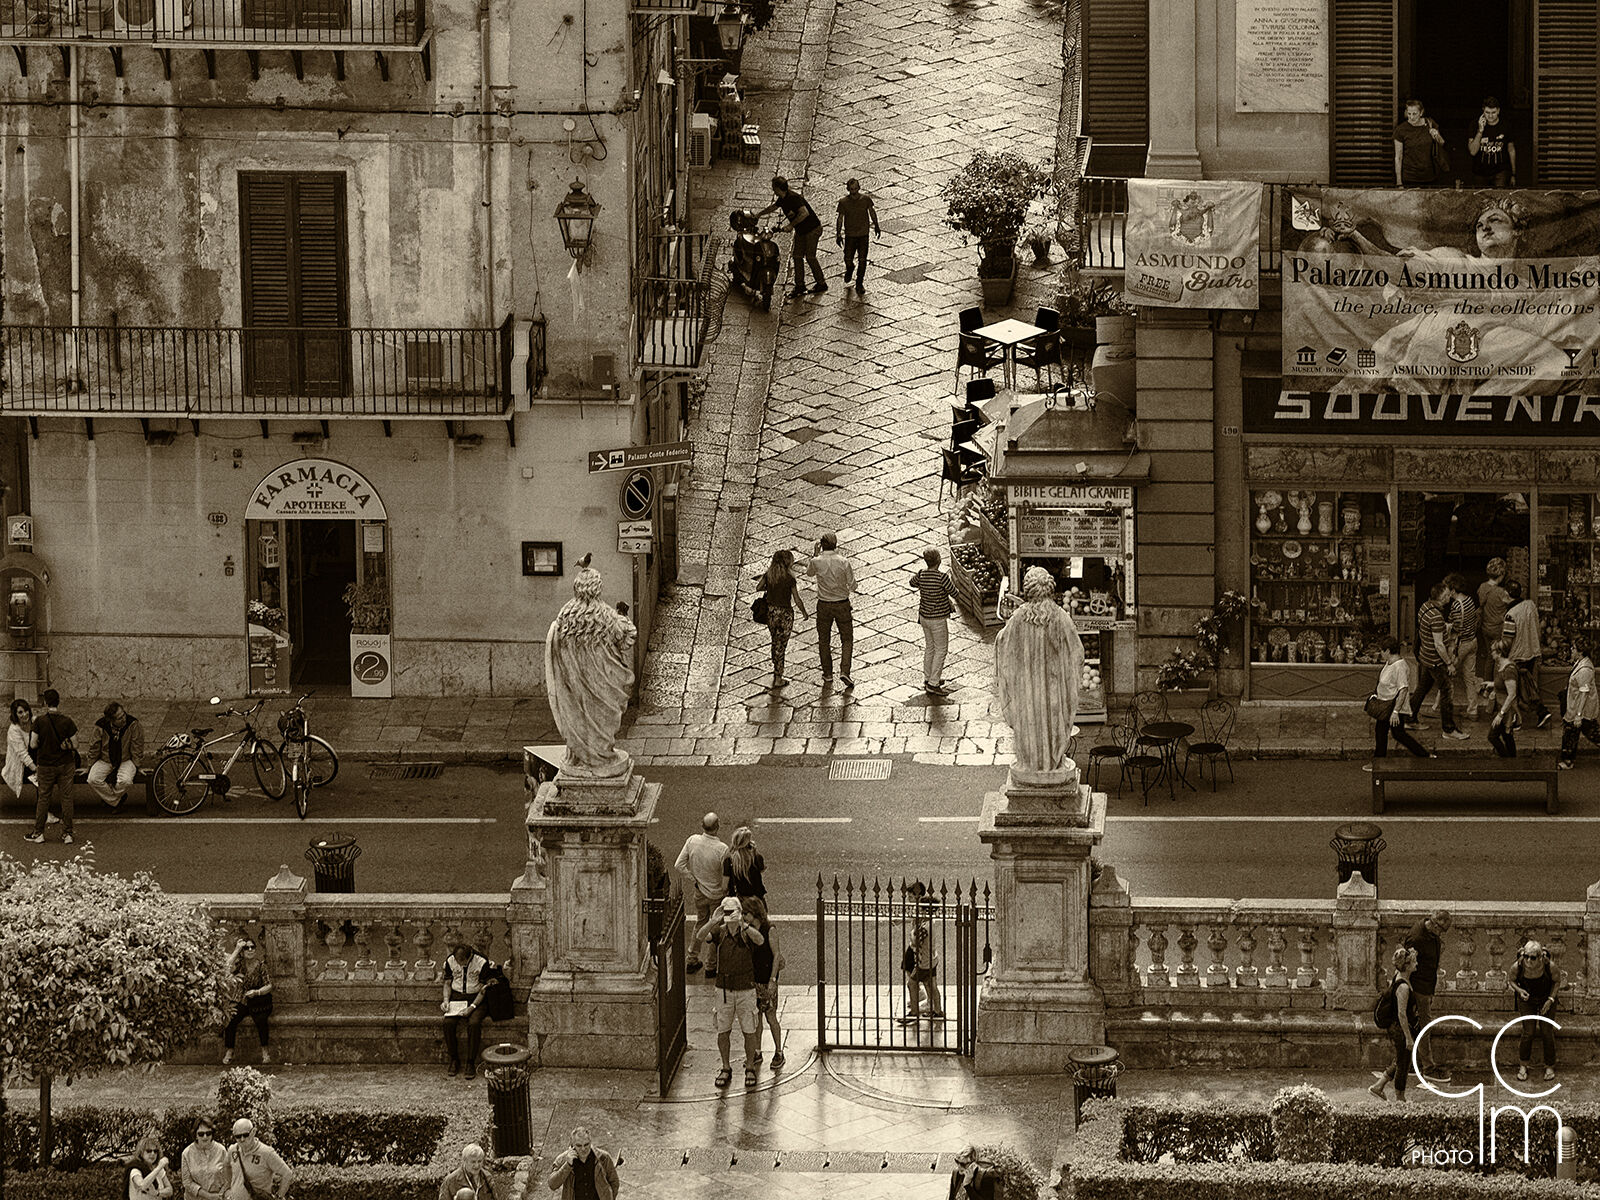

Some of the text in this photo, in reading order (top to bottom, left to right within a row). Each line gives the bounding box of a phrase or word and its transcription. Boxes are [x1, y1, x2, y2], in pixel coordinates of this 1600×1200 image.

[1135, 252, 1246, 270] ASMUNDO
[1185, 270, 1255, 292] Bistro
[1292, 257, 1600, 290] Palazzo Asmundo Muse
[1140, 274, 1171, 290] FREE
[1334, 297, 1595, 318] the palace, the collections
[1392, 365, 1447, 376] ASMUNDO
[1497, 366, 1536, 376] INSIDE
[666, 448, 688, 456] Federico
[255, 466, 371, 510] FARMACIA
[1014, 486, 1130, 499] BIBITE GELATI GRANITE
[283, 500, 347, 510] APOTHEKE
[251, 1155, 261, 1165] 15
